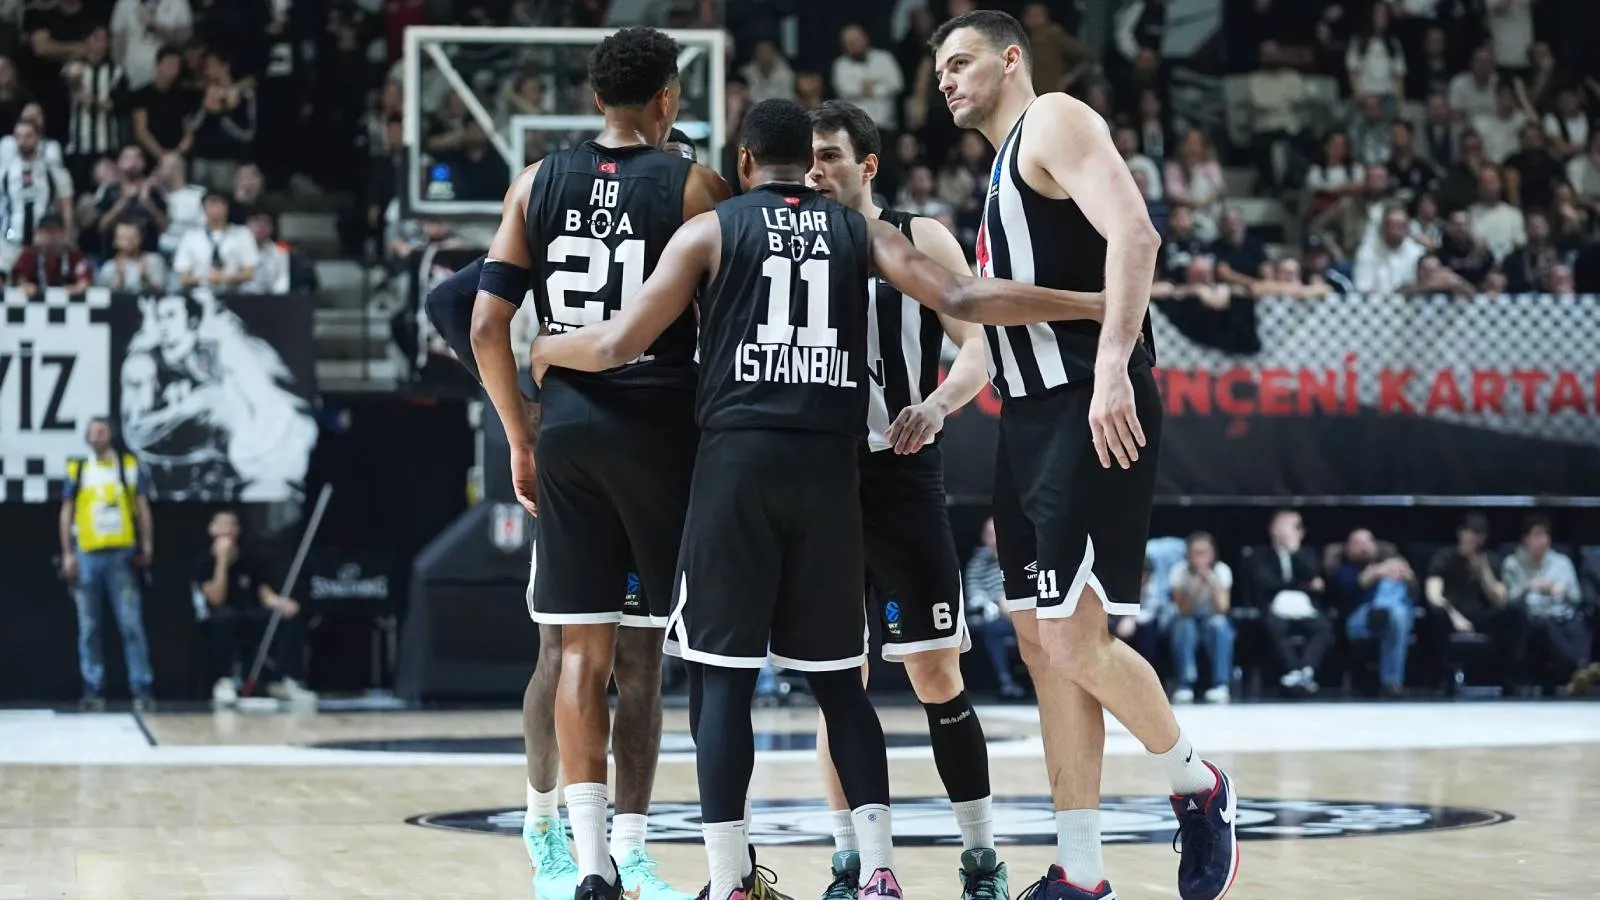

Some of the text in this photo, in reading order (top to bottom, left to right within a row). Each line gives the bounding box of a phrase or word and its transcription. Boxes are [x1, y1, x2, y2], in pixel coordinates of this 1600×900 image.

[589, 178, 620, 208] AB
[546, 235, 646, 327] 21
[756, 254, 838, 348] 11
[1150, 352, 1358, 441] NÇENİ
[1037, 569, 1060, 599] 41
[932, 602, 953, 630] 6
